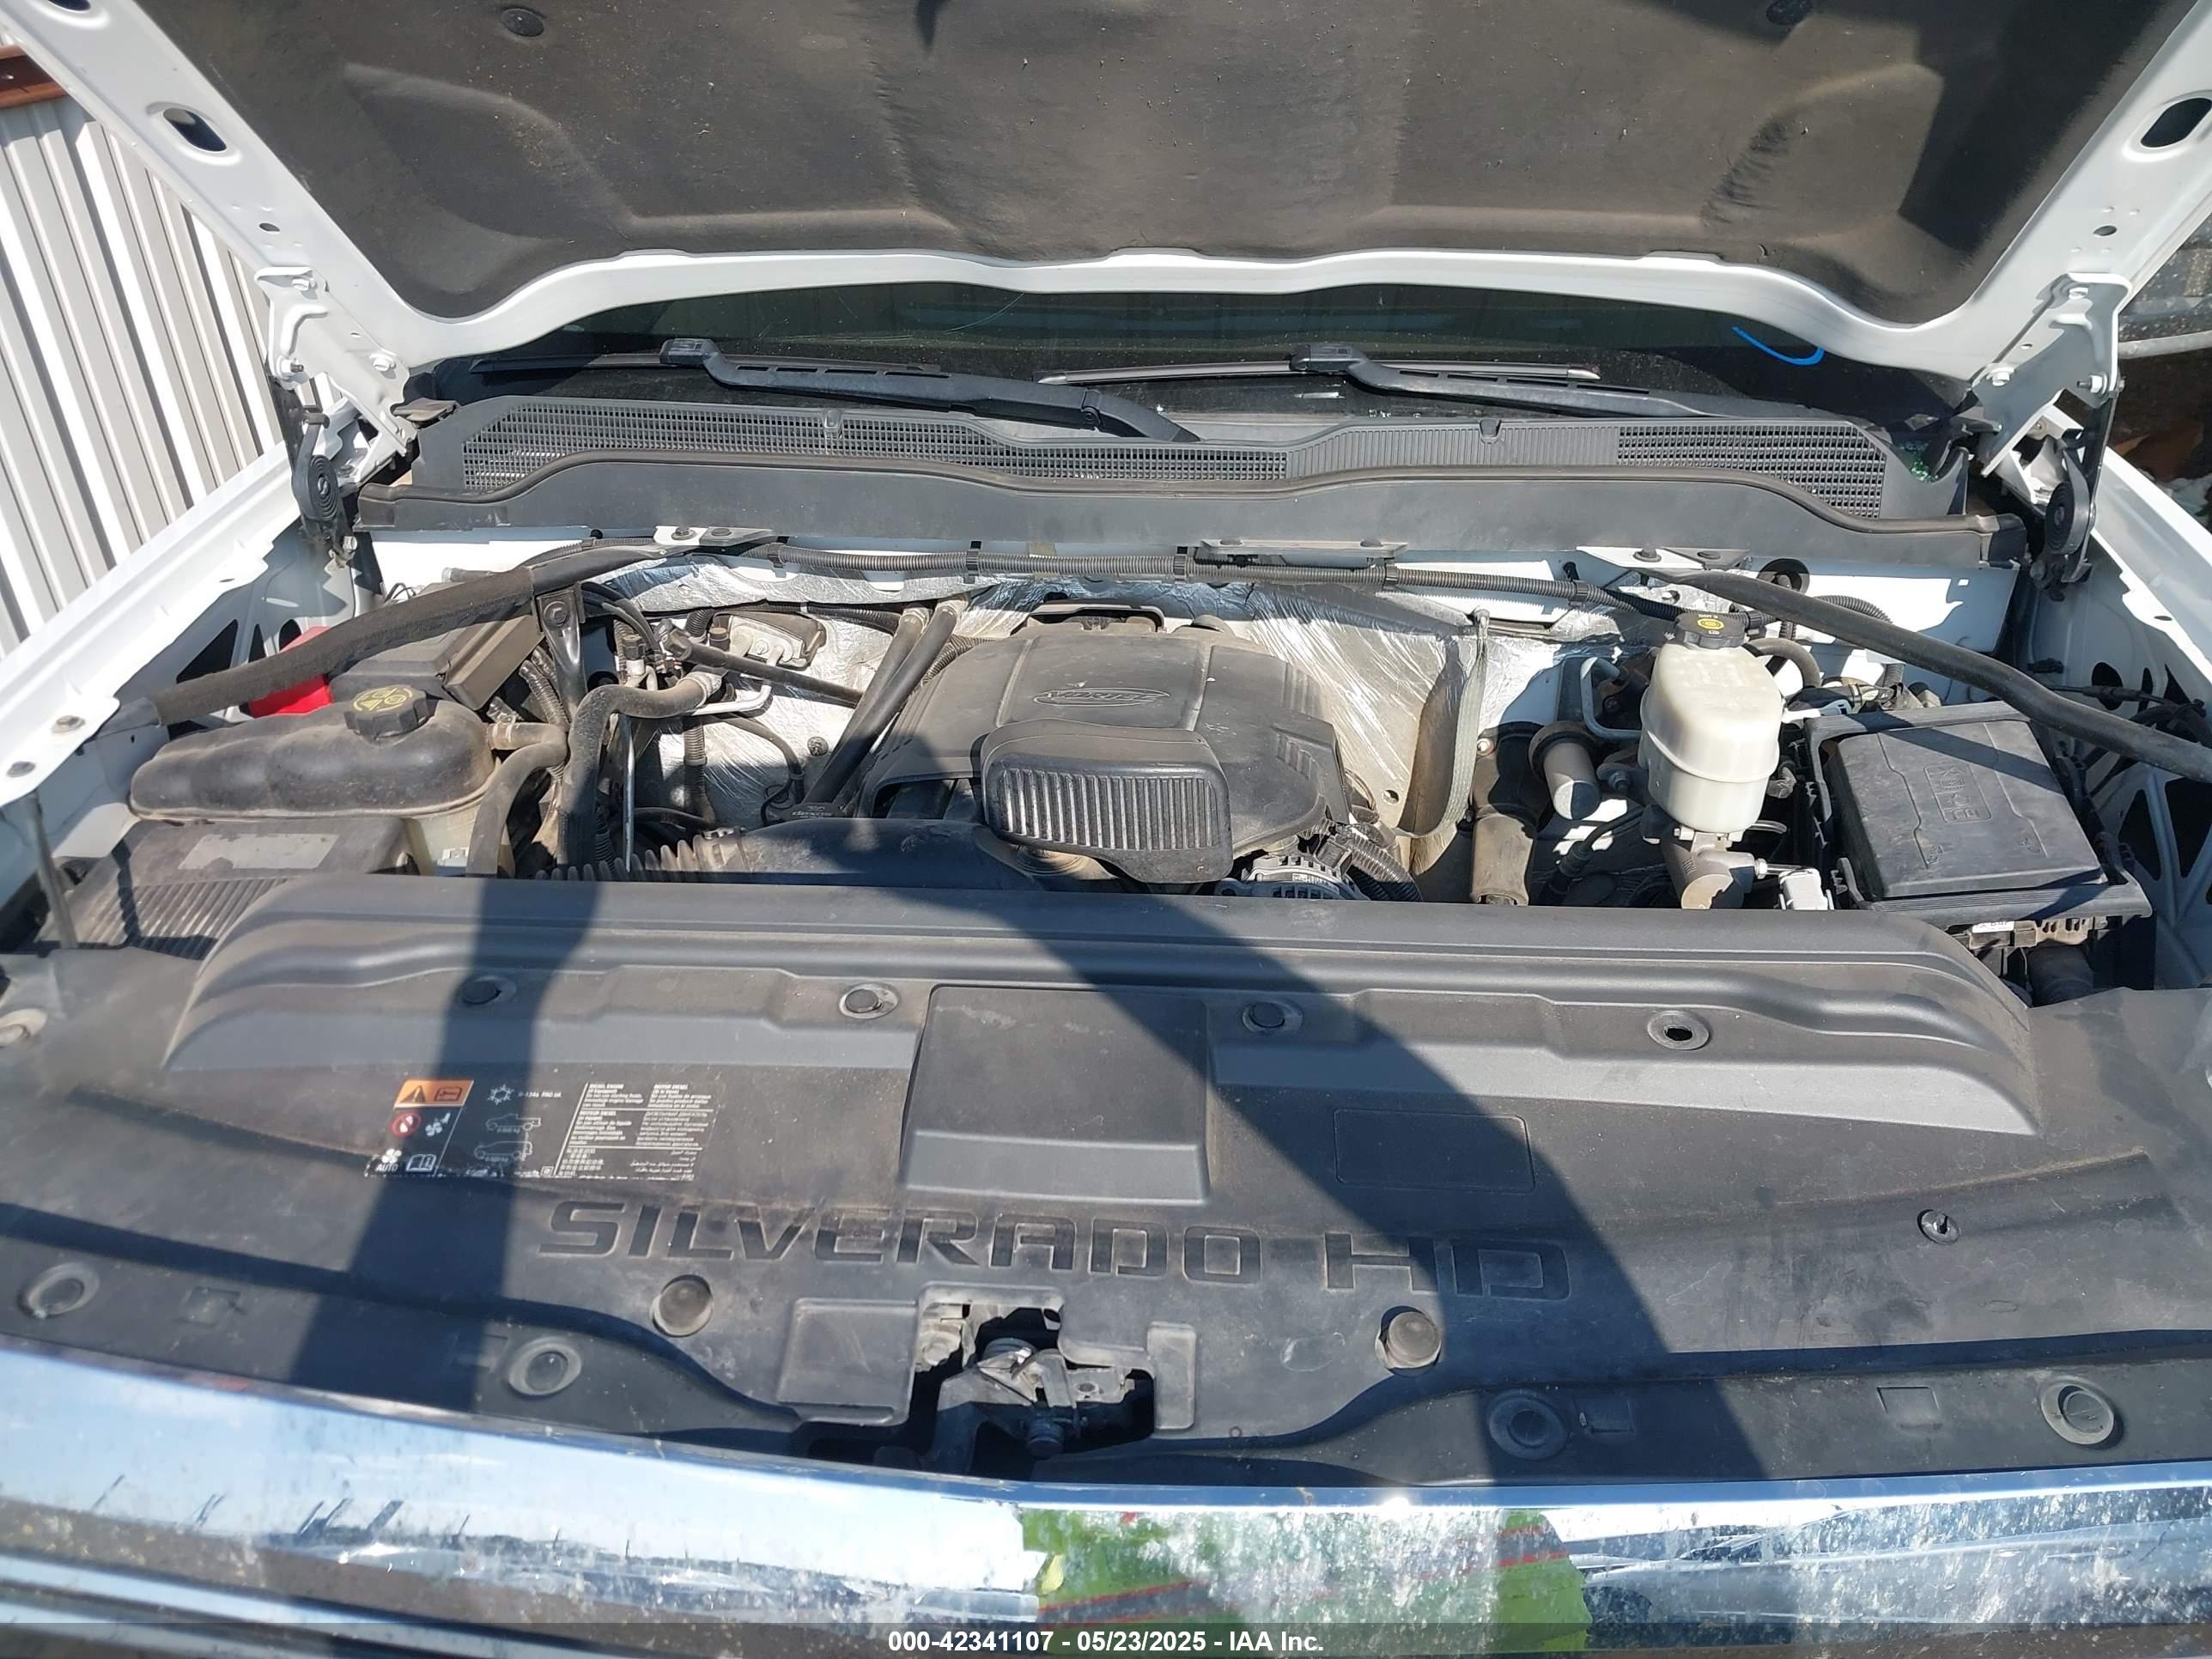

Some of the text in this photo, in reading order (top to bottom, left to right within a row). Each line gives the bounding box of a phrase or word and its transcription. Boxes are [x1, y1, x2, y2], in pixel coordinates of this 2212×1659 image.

[375, 1164, 398, 1172] AUTO
[538, 1200, 1571, 1301] SILVERADO HD
